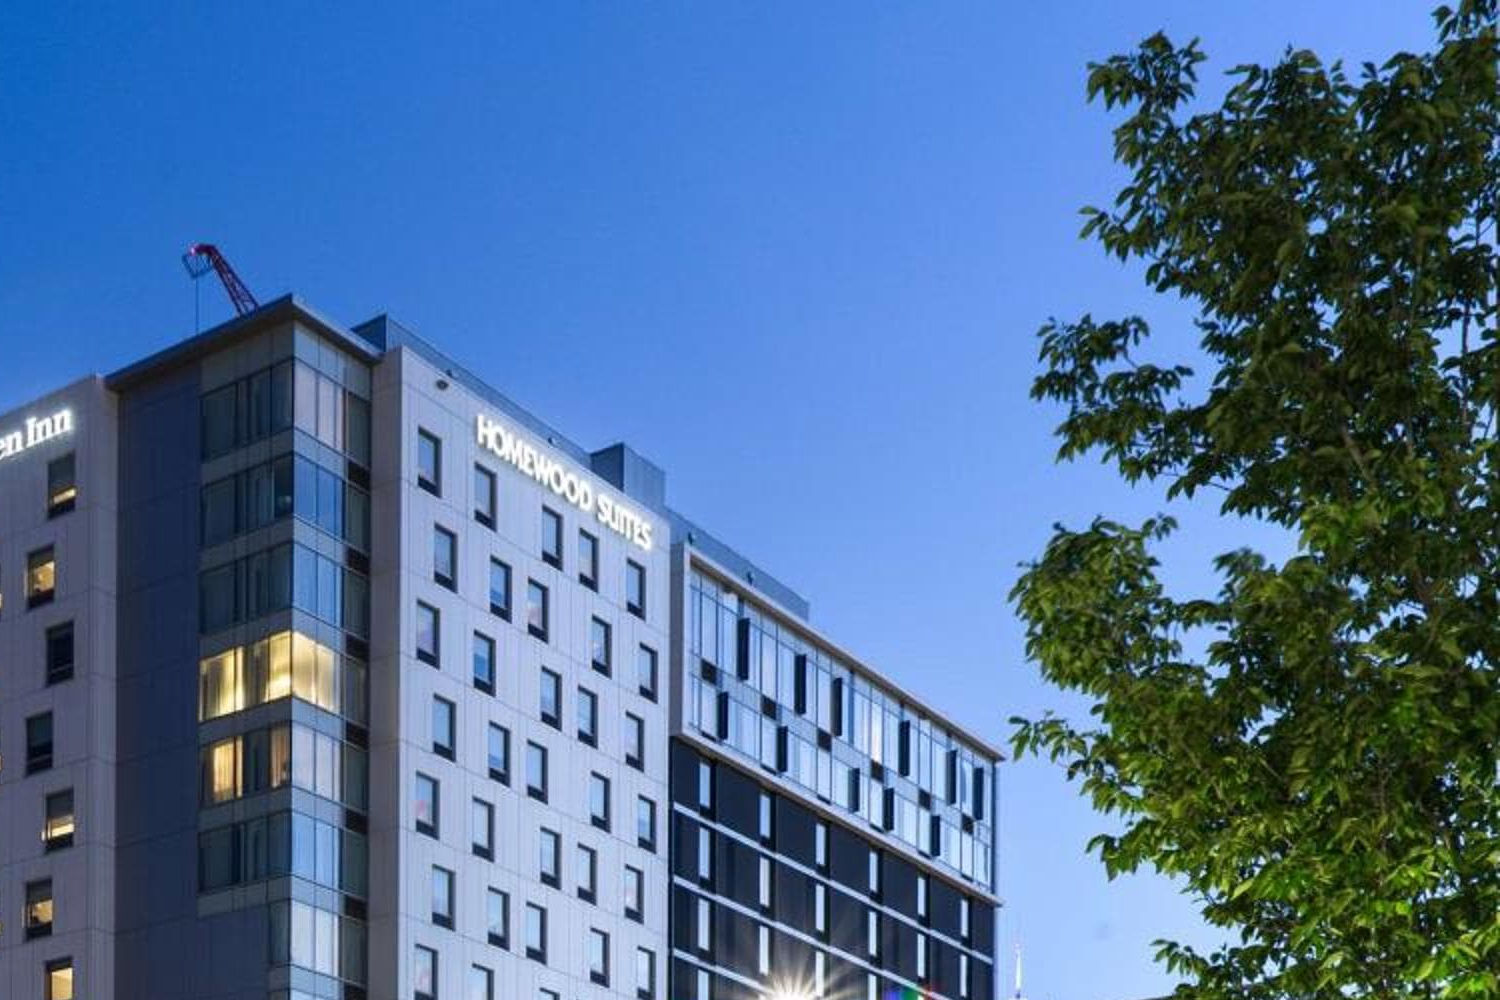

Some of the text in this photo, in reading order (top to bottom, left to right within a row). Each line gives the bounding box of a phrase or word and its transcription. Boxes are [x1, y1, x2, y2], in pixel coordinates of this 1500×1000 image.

[26, 408, 73, 447] Inn
[476, 414, 652, 550] HOMEWOOD SUITES
